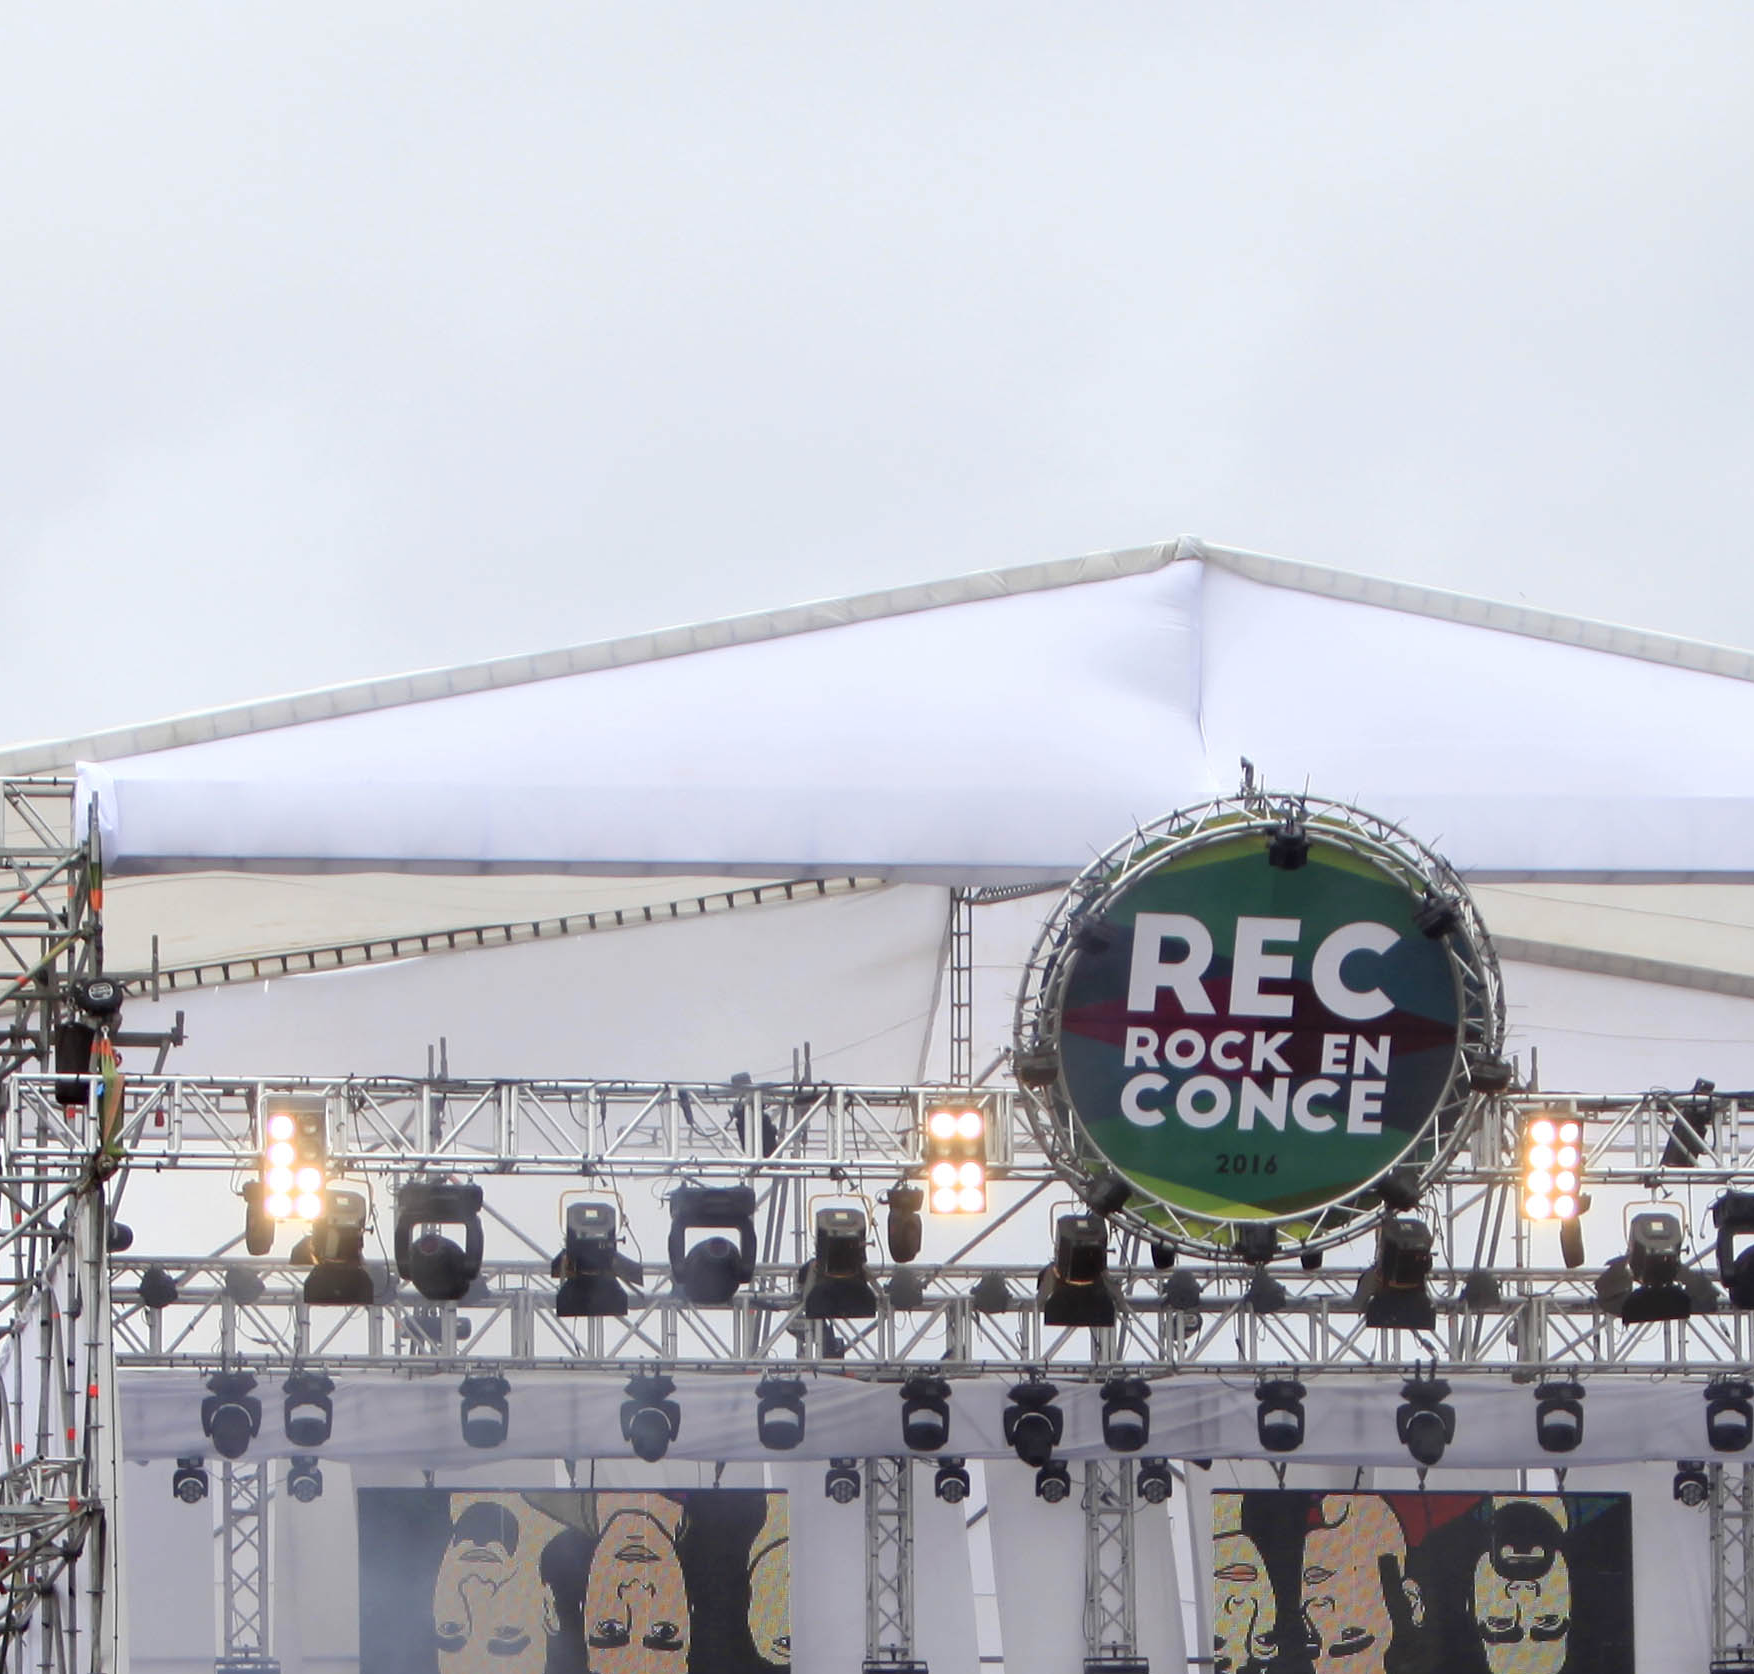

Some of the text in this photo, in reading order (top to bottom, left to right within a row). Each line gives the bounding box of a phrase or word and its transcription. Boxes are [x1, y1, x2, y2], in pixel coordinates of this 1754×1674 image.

[1127, 912, 1402, 1020] REC
[1123, 1027, 1392, 1076] ROCK EN
[1120, 1074, 1387, 1134] CONCE
[1215, 1153, 1279, 1176] 2016
